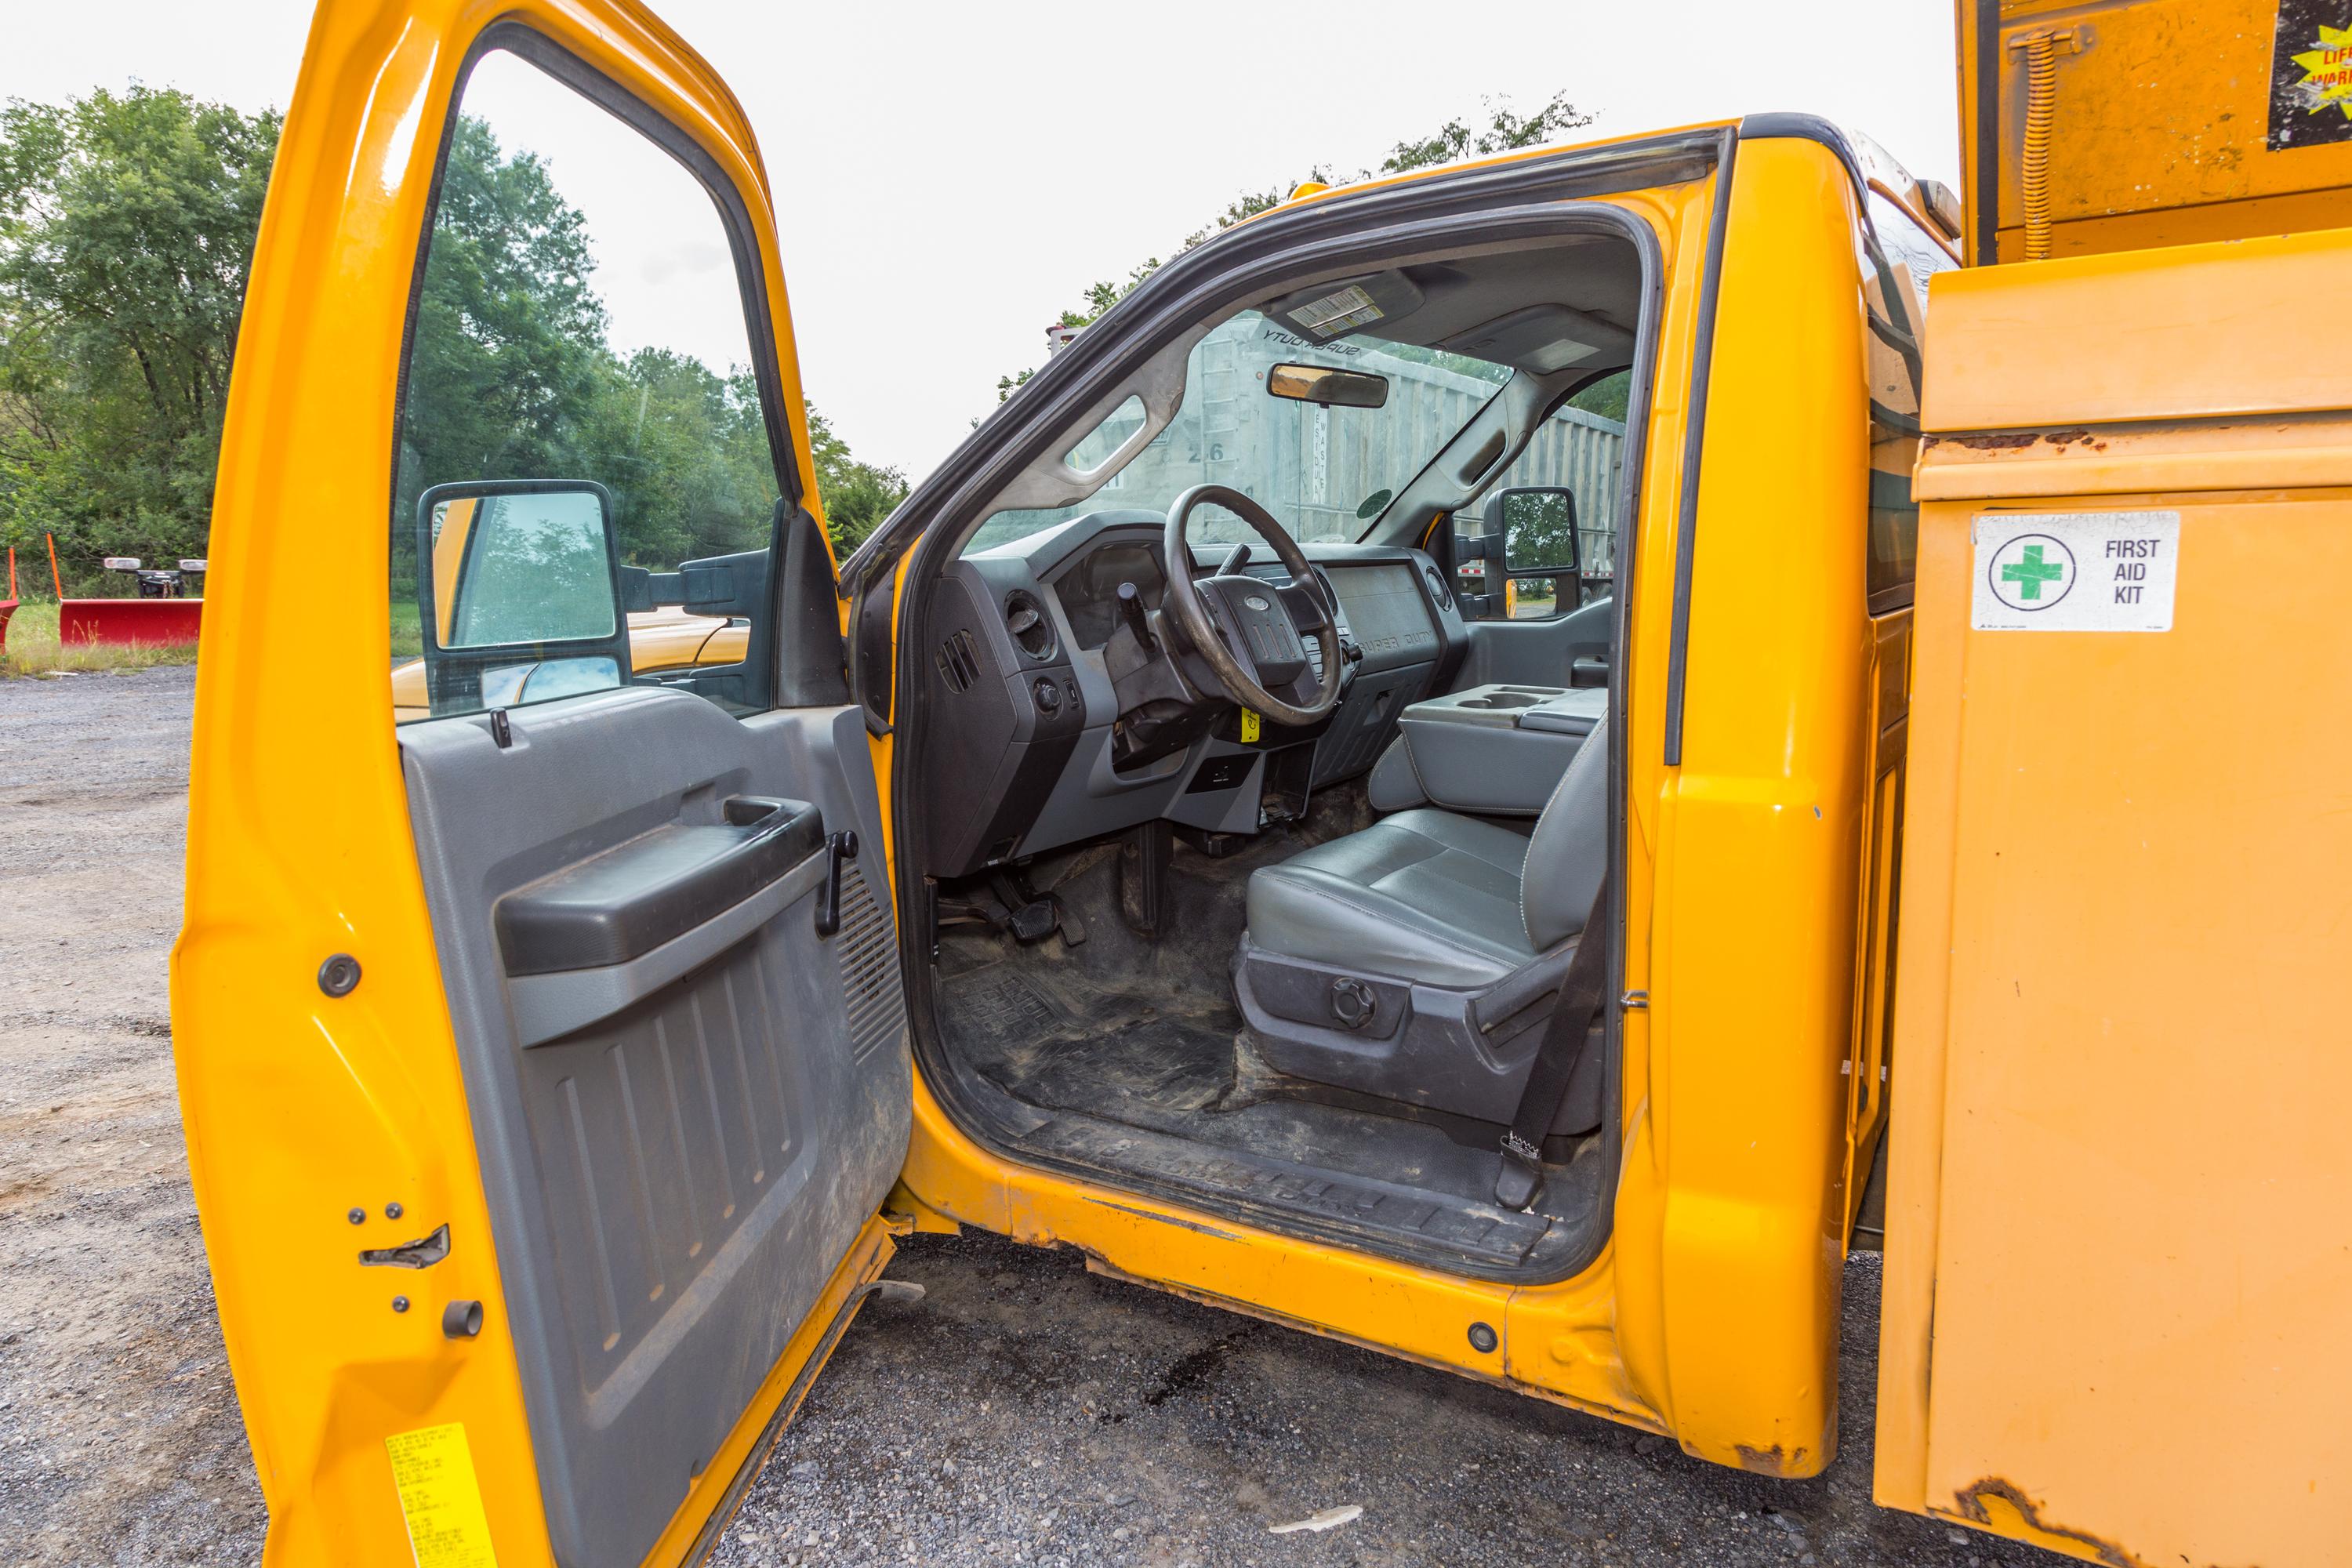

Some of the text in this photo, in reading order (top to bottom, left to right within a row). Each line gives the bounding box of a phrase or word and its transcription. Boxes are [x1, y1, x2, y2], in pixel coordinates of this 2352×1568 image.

[2324, 45, 2352, 65] LIF
[2312, 69, 2352, 86] WAR
[2105, 539, 2161, 558] FIRST
[2114, 563, 2146, 581] AID
[2114, 586, 2144, 604] KIT
[1358, 630, 1432, 654] SUPER DUTY
